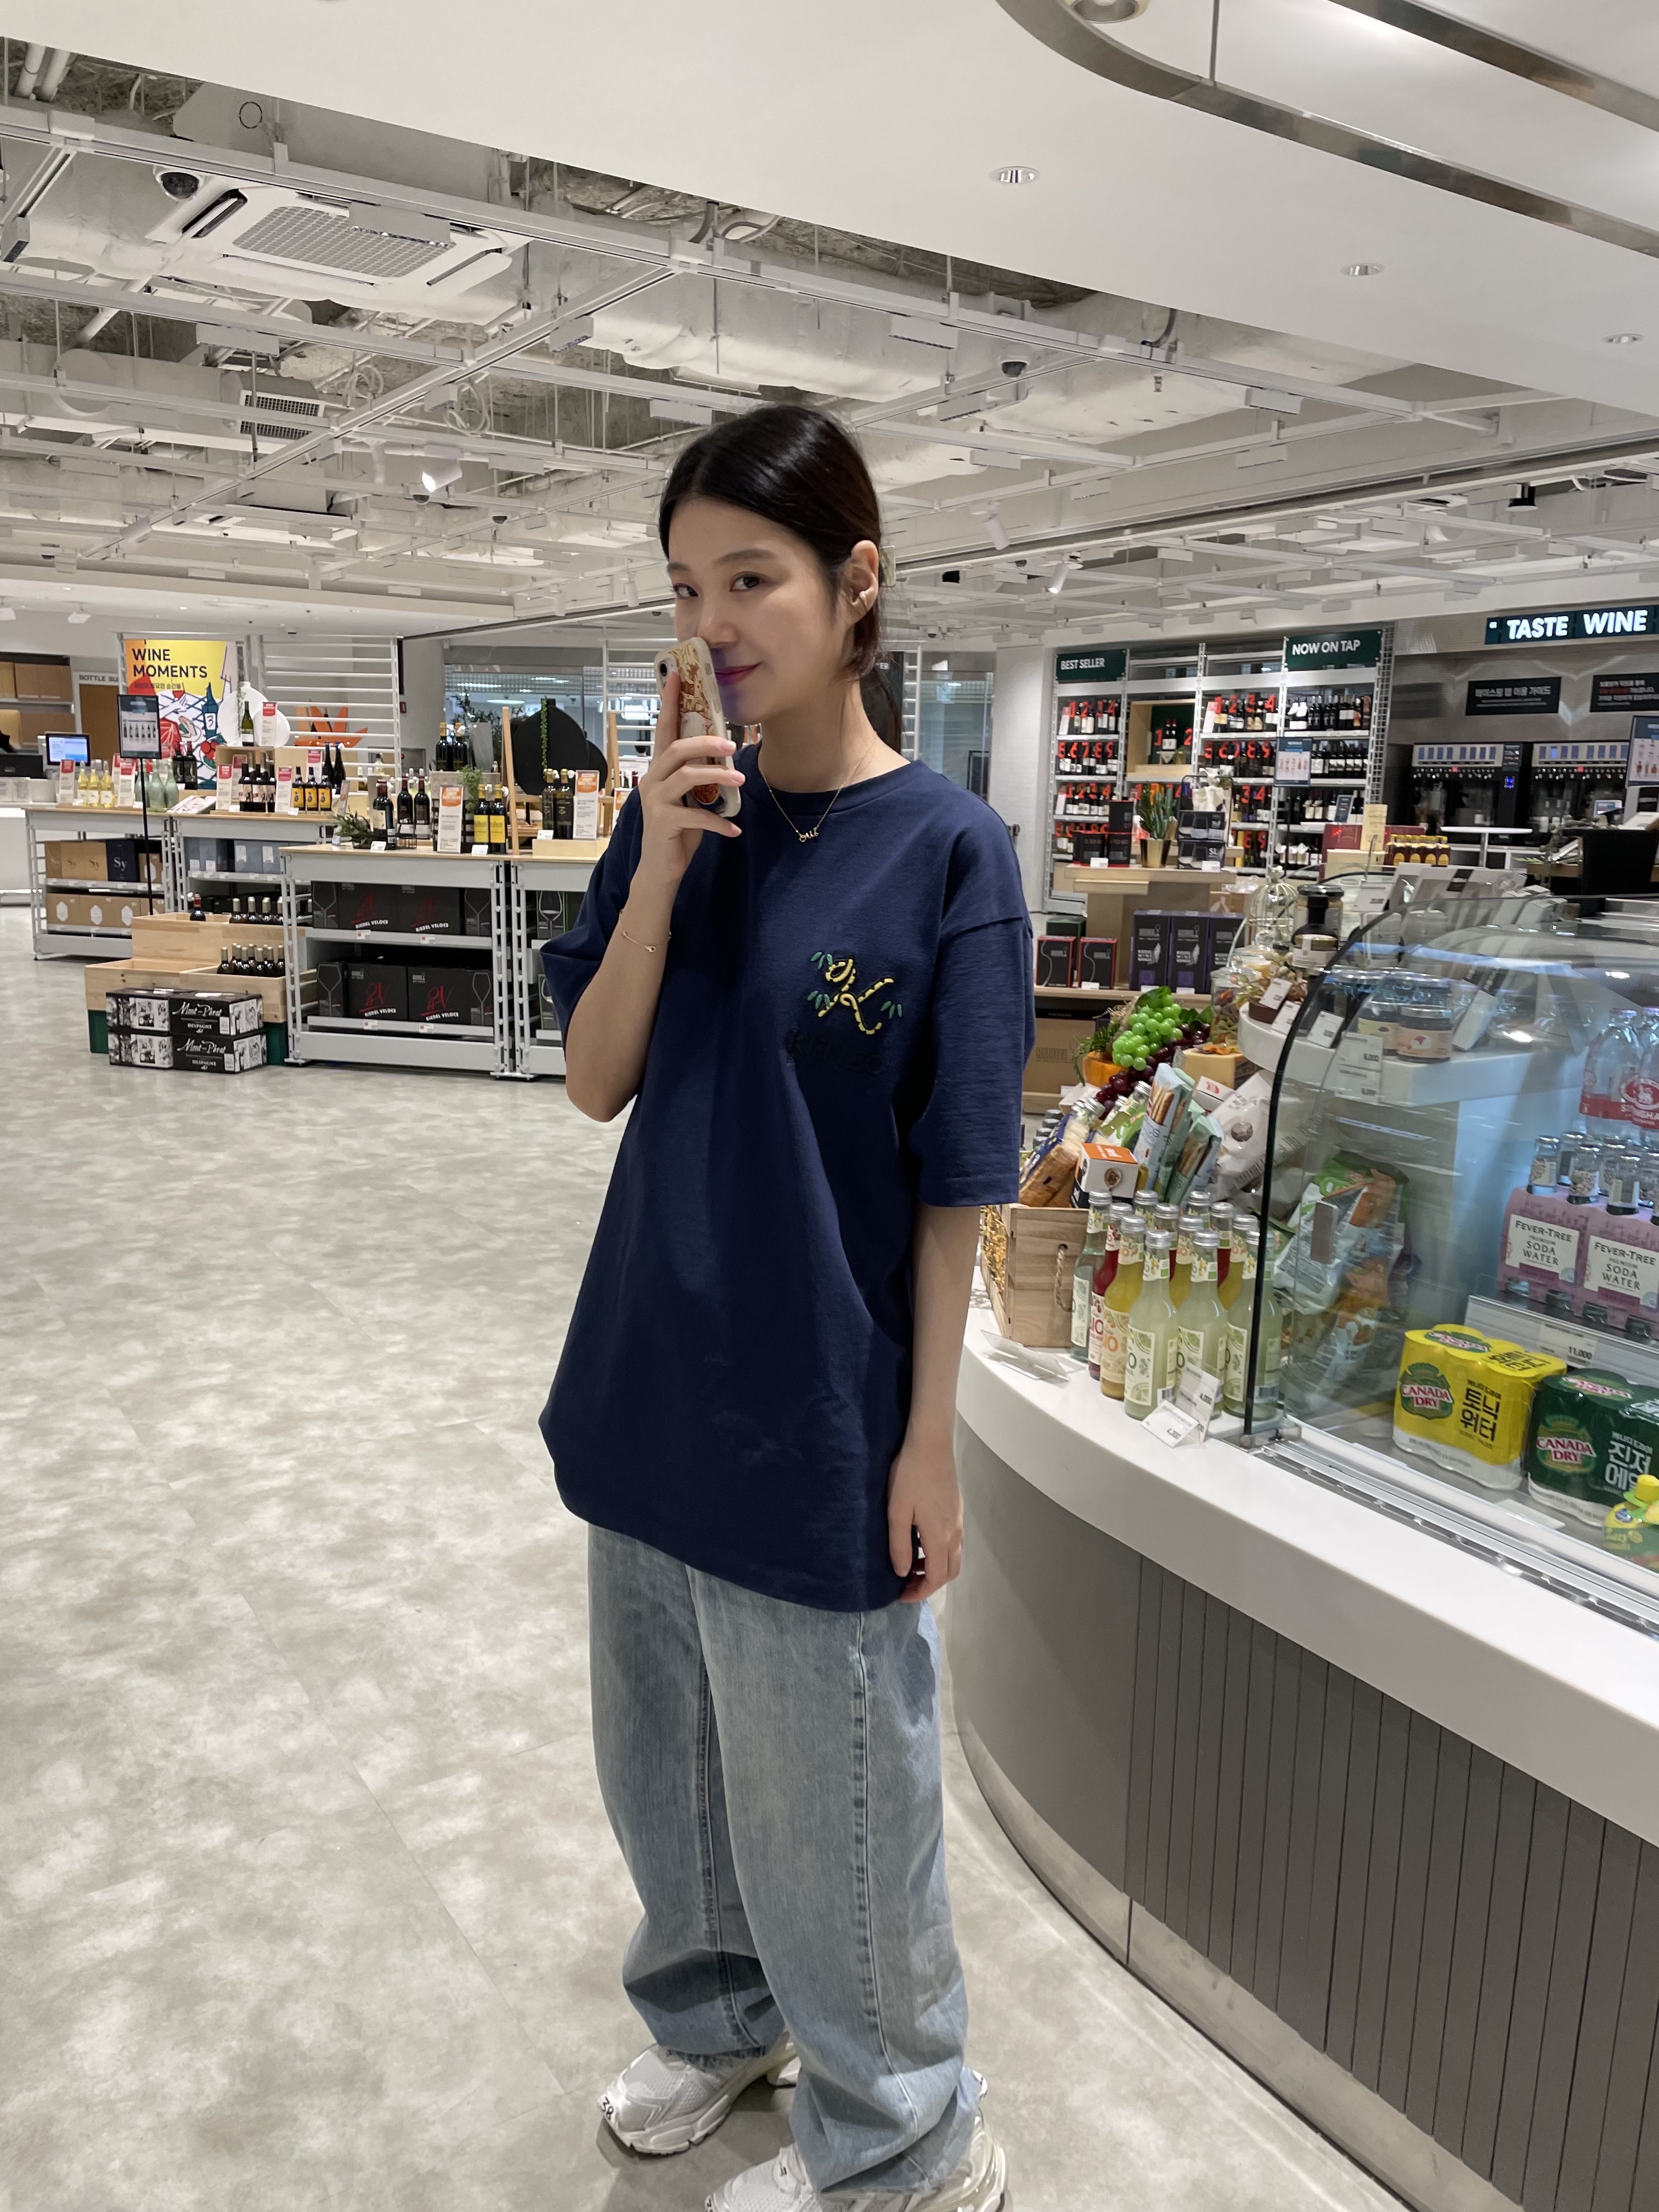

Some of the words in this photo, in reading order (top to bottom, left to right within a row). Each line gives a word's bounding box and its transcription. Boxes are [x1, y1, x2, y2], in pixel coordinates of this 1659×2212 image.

[1506, 616, 1569, 640] TASTE
[1583, 610, 1648, 635] WINE
[132, 648, 171, 661] WINE
[1292, 642, 1320, 655] NOW
[1321, 641, 1339, 653] ON
[1340, 640, 1361, 652] TAP
[133, 664, 207, 678] MOMENTS
[1060, 659, 1079, 670] BEST
[1079, 658, 1105, 668] SELLER
[1069, 702, 1076, 718] 1
[1081, 701, 1088, 718] 2
[1108, 699, 1116, 716] 4
[1214, 696, 1222, 714] 1
[1228, 694, 1238, 713] 2
[1245, 693, 1255, 713] 3
[1265, 693, 1276, 712] 4
[206, 715, 214, 727] 3
[1154, 729, 1163, 747] 1
[1183, 728, 1193, 746] 2
[1081, 742, 1090, 758] 7
[1066, 782, 1073, 798] 1
[1102, 783, 1111, 798] 4
[1241, 785, 1250, 804] 3
[1255, 785, 1265, 803] 4
[1257, 831, 1267, 849] 9
[114, 856, 127, 872] Sy
[1515, 1220, 1572, 1242] FEVER-TREE
[1526, 1240, 1556, 1255] SODA
[1594, 1242, 1656, 1265] FEVER-TREE
[1523, 1249, 1559, 1266] WATER
[1606, 1263, 1638, 1279] SODA
[1602, 1272, 1641, 1290] WATER
[1402, 1385, 1451, 1401] CANADA
[1415, 1397, 1438, 1408] DRY
[1463, 1387, 1500, 1420] 토닉
[1460, 1408, 1497, 1442] 워터
[1537, 1437, 1595, 1456] CANADA
[1553, 1450, 1579, 1462] DRY
[1608, 1440, 1652, 1475] 진저
[601, 2096, 614, 2120] 38
